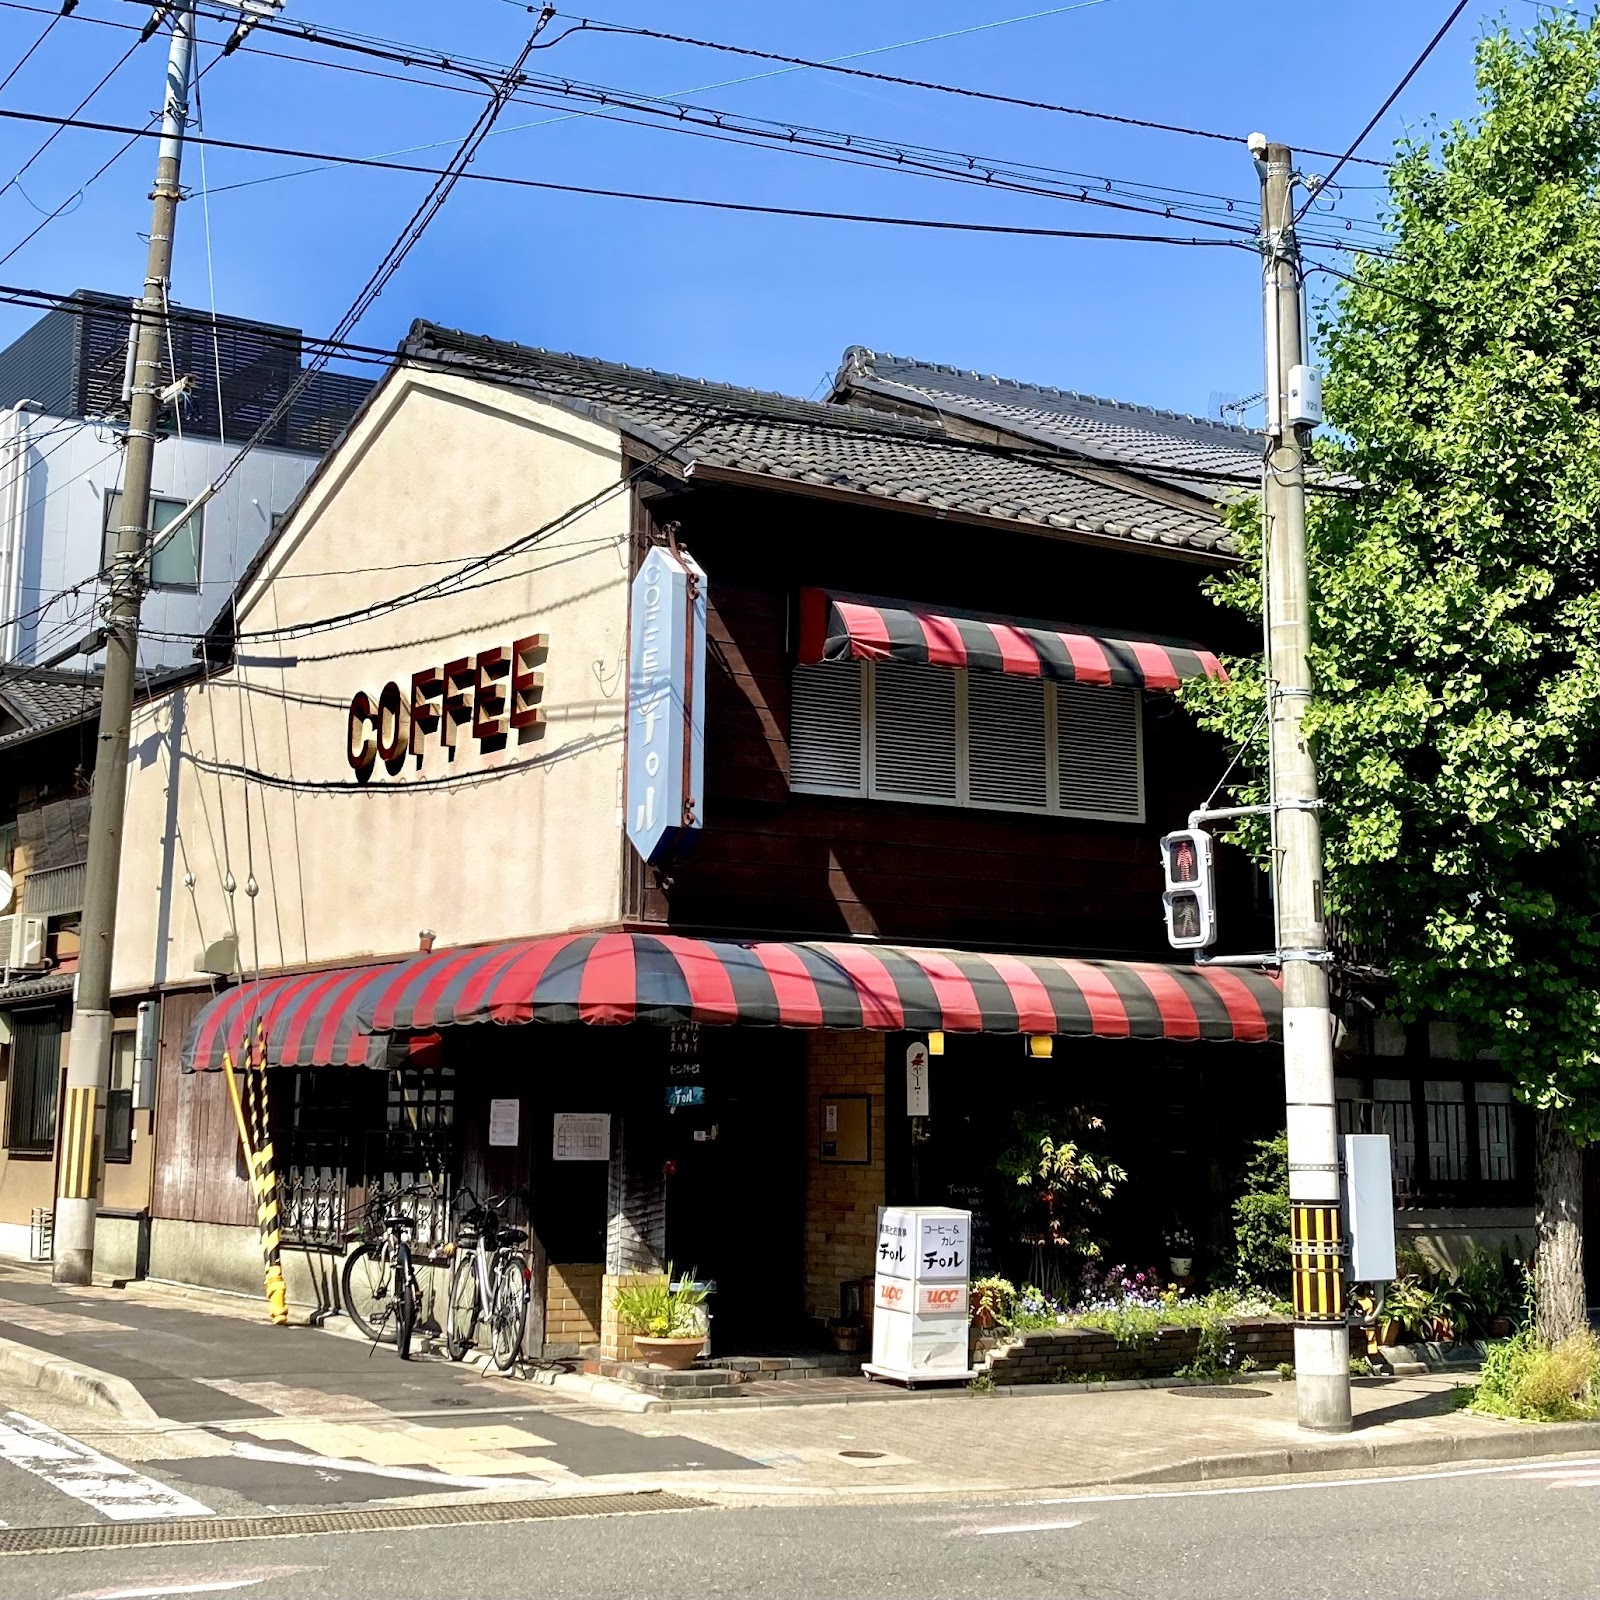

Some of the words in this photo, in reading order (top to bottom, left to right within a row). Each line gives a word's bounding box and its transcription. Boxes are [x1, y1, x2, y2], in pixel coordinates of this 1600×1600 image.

[642, 563, 661, 689] COFFEE
[347, 633, 549, 772] COFFEE
[635, 699, 662, 834] チロル
[924, 1225, 960, 1235] コーヒー&
[941, 1236, 964, 1246] カレー
[879, 1242, 906, 1262] チロル
[923, 1250, 964, 1270] チロル
